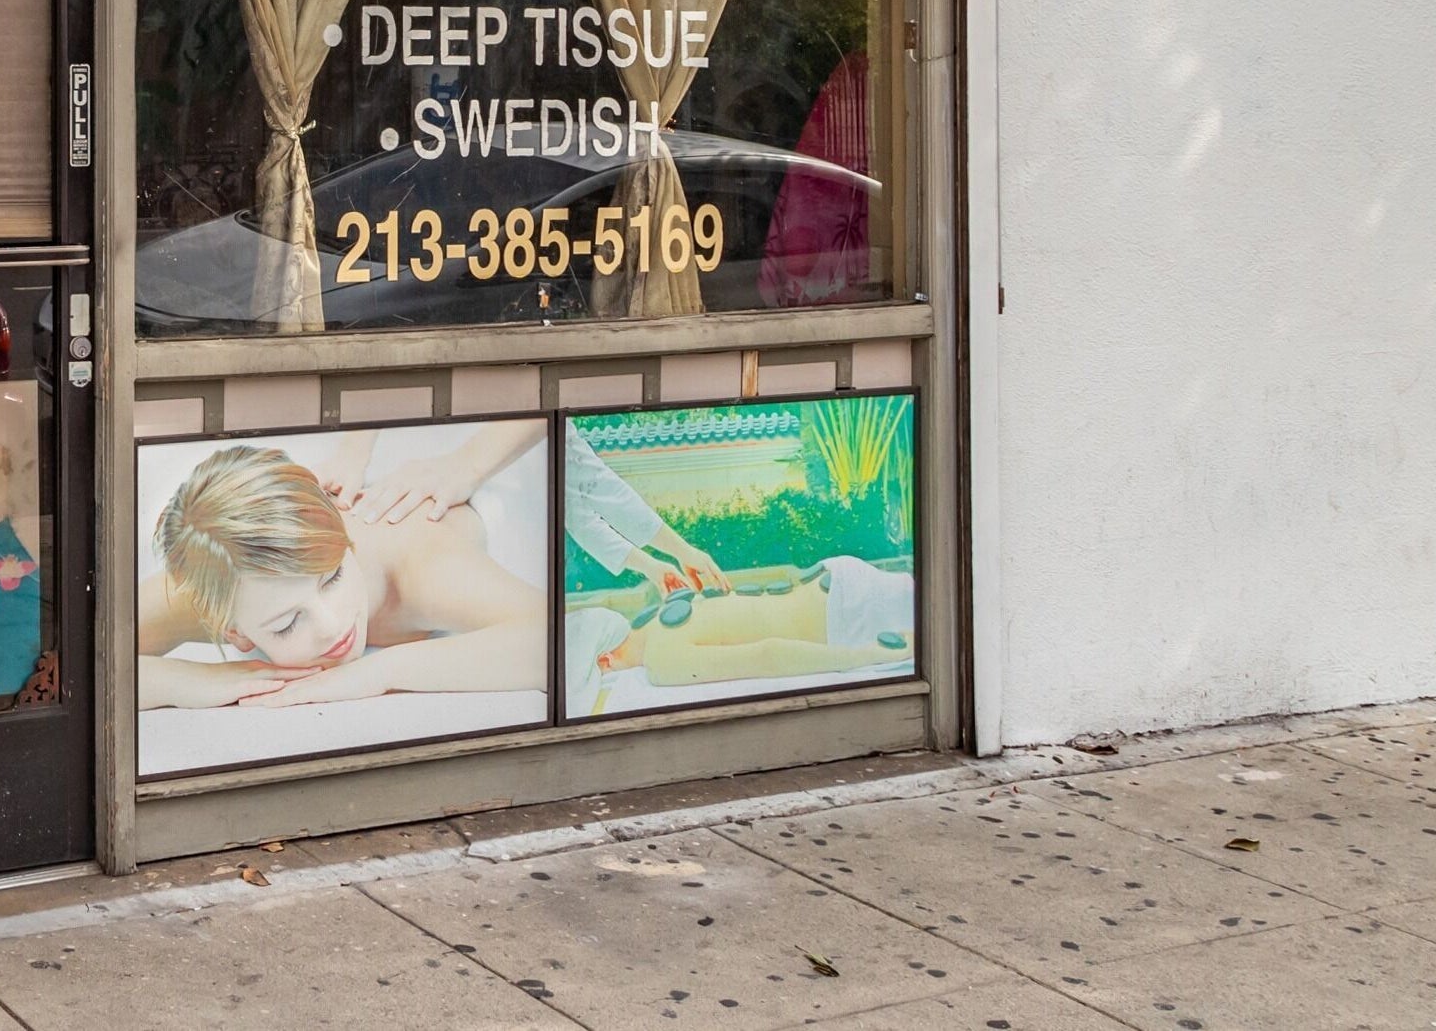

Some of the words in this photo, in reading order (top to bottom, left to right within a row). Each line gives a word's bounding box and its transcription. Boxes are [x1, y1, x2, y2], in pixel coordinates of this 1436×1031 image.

[361, 5, 509, 67] DEEP
[524, 6, 709, 68] TISSUE
[72, 73, 88, 139] PULL
[413, 96, 660, 161] SWEDISH
[335, 202, 725, 284] 213-385-5169
